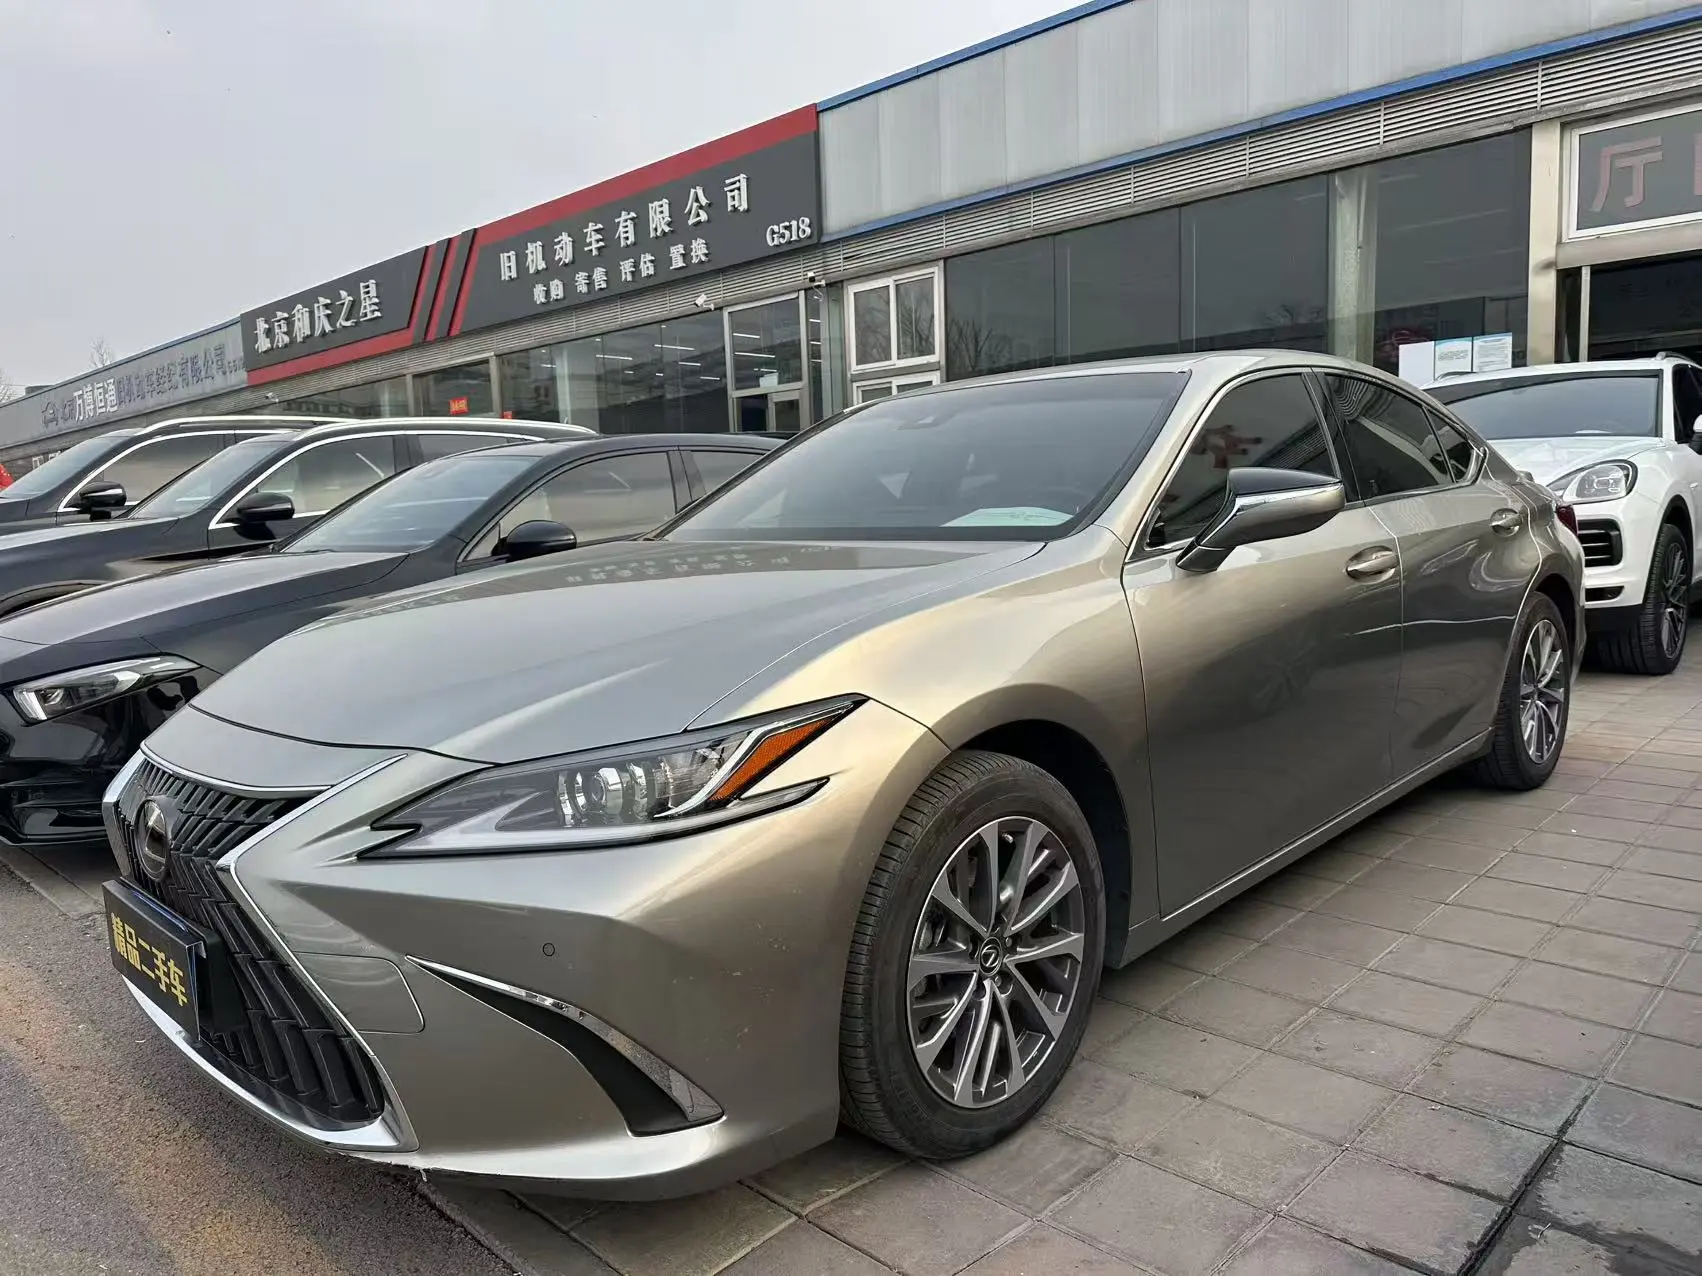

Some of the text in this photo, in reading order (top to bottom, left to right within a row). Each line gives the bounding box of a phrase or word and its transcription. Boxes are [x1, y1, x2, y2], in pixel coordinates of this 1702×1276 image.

[1588, 133, 1702, 212] 厅
[500, 173, 749, 281] 旧机动车有限公司
[765, 217, 812, 247] G518
[533, 237, 709, 305] 收购 寄售 评估 置换
[254, 279, 382, 353] 北京和庆之星
[110, 912, 188, 1007] 精品二手车
